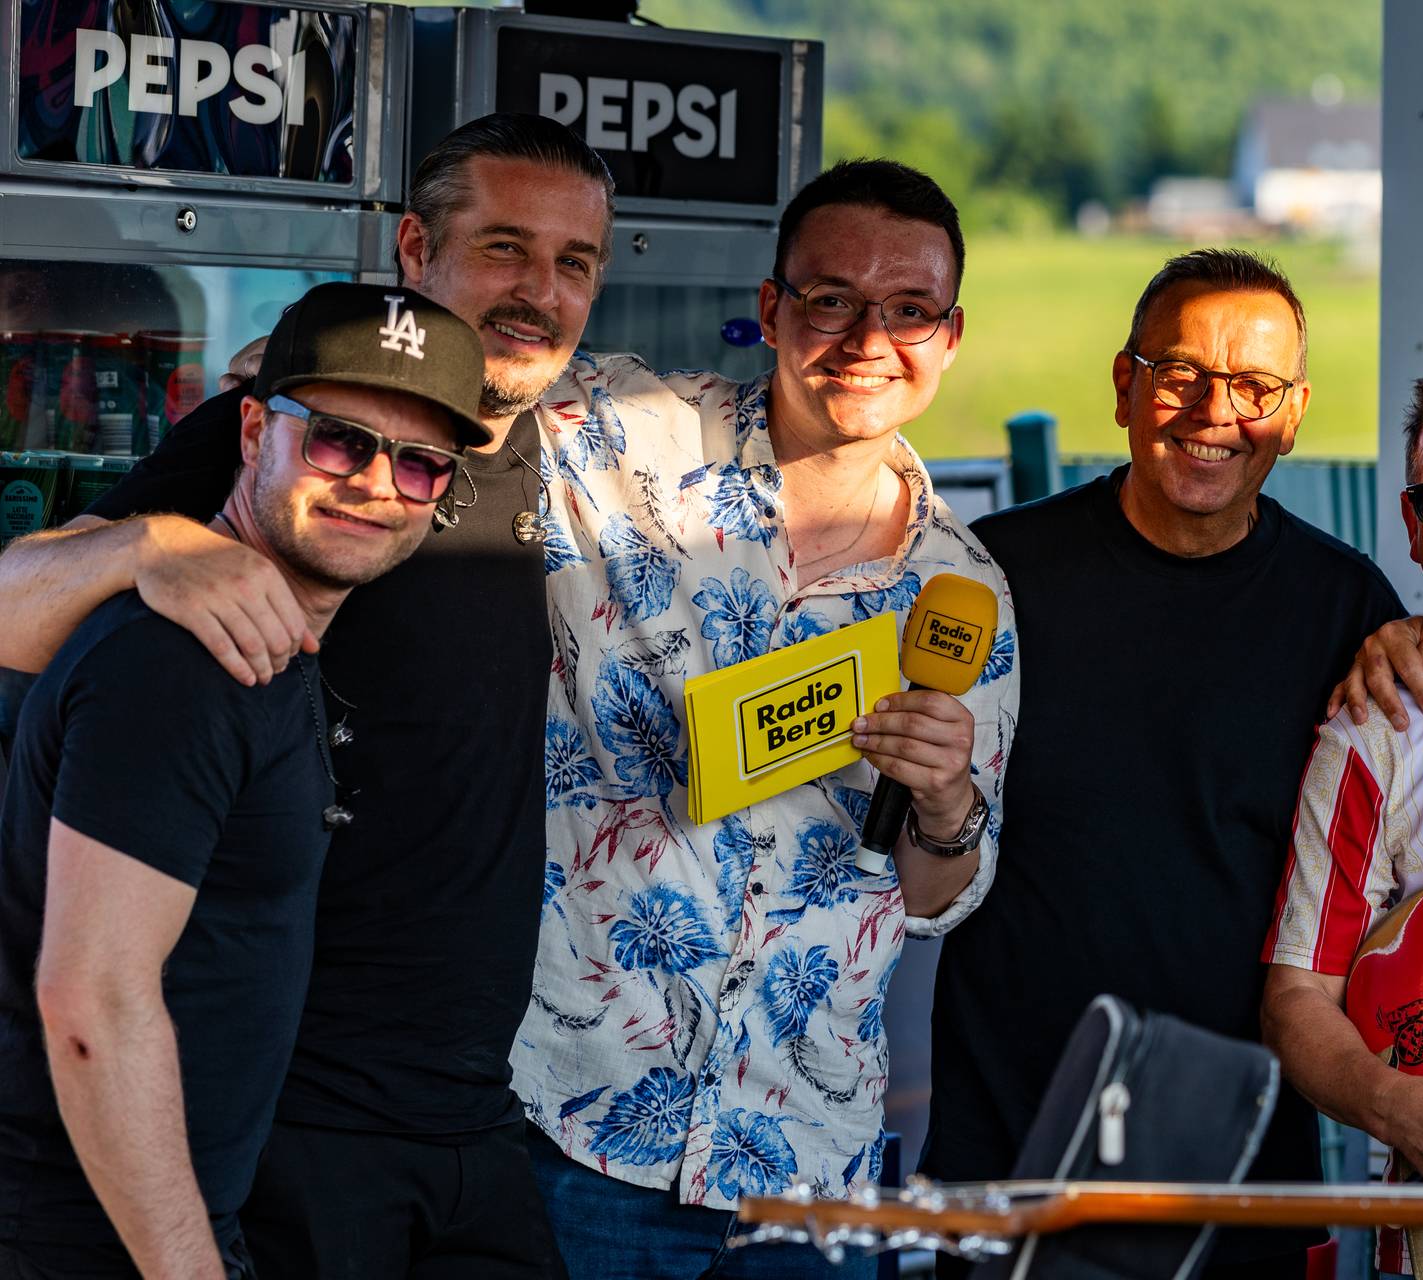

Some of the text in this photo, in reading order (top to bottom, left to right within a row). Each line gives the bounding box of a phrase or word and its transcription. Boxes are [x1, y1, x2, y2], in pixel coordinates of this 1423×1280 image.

[74, 28, 305, 125] PEPSI
[538, 73, 737, 159] PEPSI
[379, 295, 426, 360] LA
[929, 619, 972, 642] Radio
[929, 633, 964, 657] Berg
[757, 682, 842, 730] Radio
[767, 710, 835, 752] Berg
